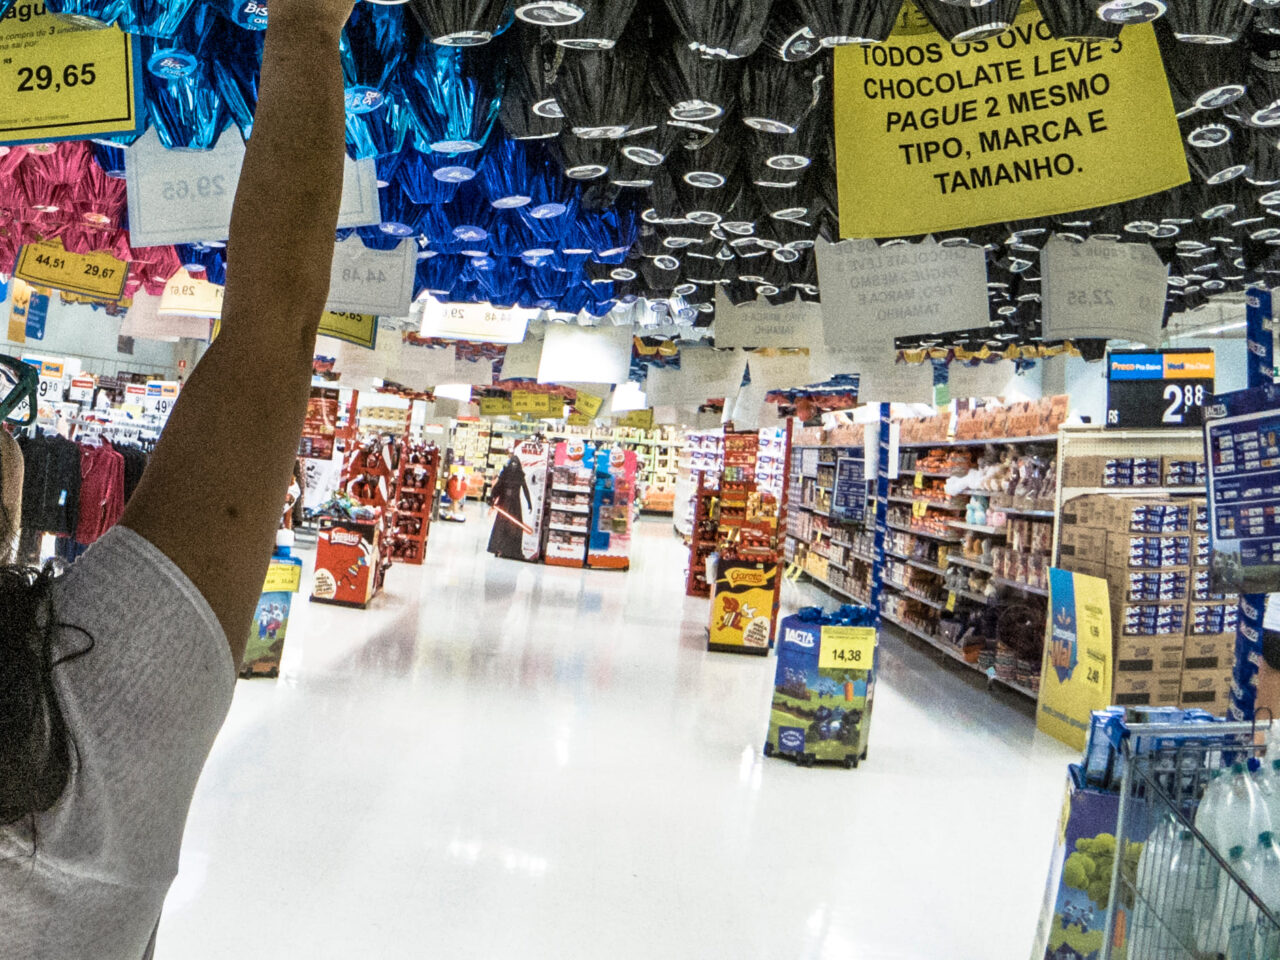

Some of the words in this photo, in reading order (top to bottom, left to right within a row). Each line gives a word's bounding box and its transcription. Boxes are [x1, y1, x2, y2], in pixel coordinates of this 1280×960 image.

[5, 2, 47, 22] agu
[48, 26, 56, 36] 3
[860, 42, 944, 67] TODOS
[17, 62, 97, 93] 29,65
[863, 59, 1026, 100] CHOCOLATE
[1033, 40, 1104, 77] LEVE
[885, 100, 979, 133] PAGUE
[984, 96, 1001, 119] 2
[1007, 72, 1111, 115] MESMO
[899, 136, 972, 166] TIPO,
[979, 117, 1084, 154] MARCA
[1088, 109, 1109, 133] E
[933, 152, 1084, 195] TAMANHO.
[34, 253, 66, 270] 44,51
[84, 263, 116, 280] 29,67
[1107, 409, 1119, 424] R$
[785, 627, 815, 648] LACTA
[831, 648, 862, 663] 14,38
